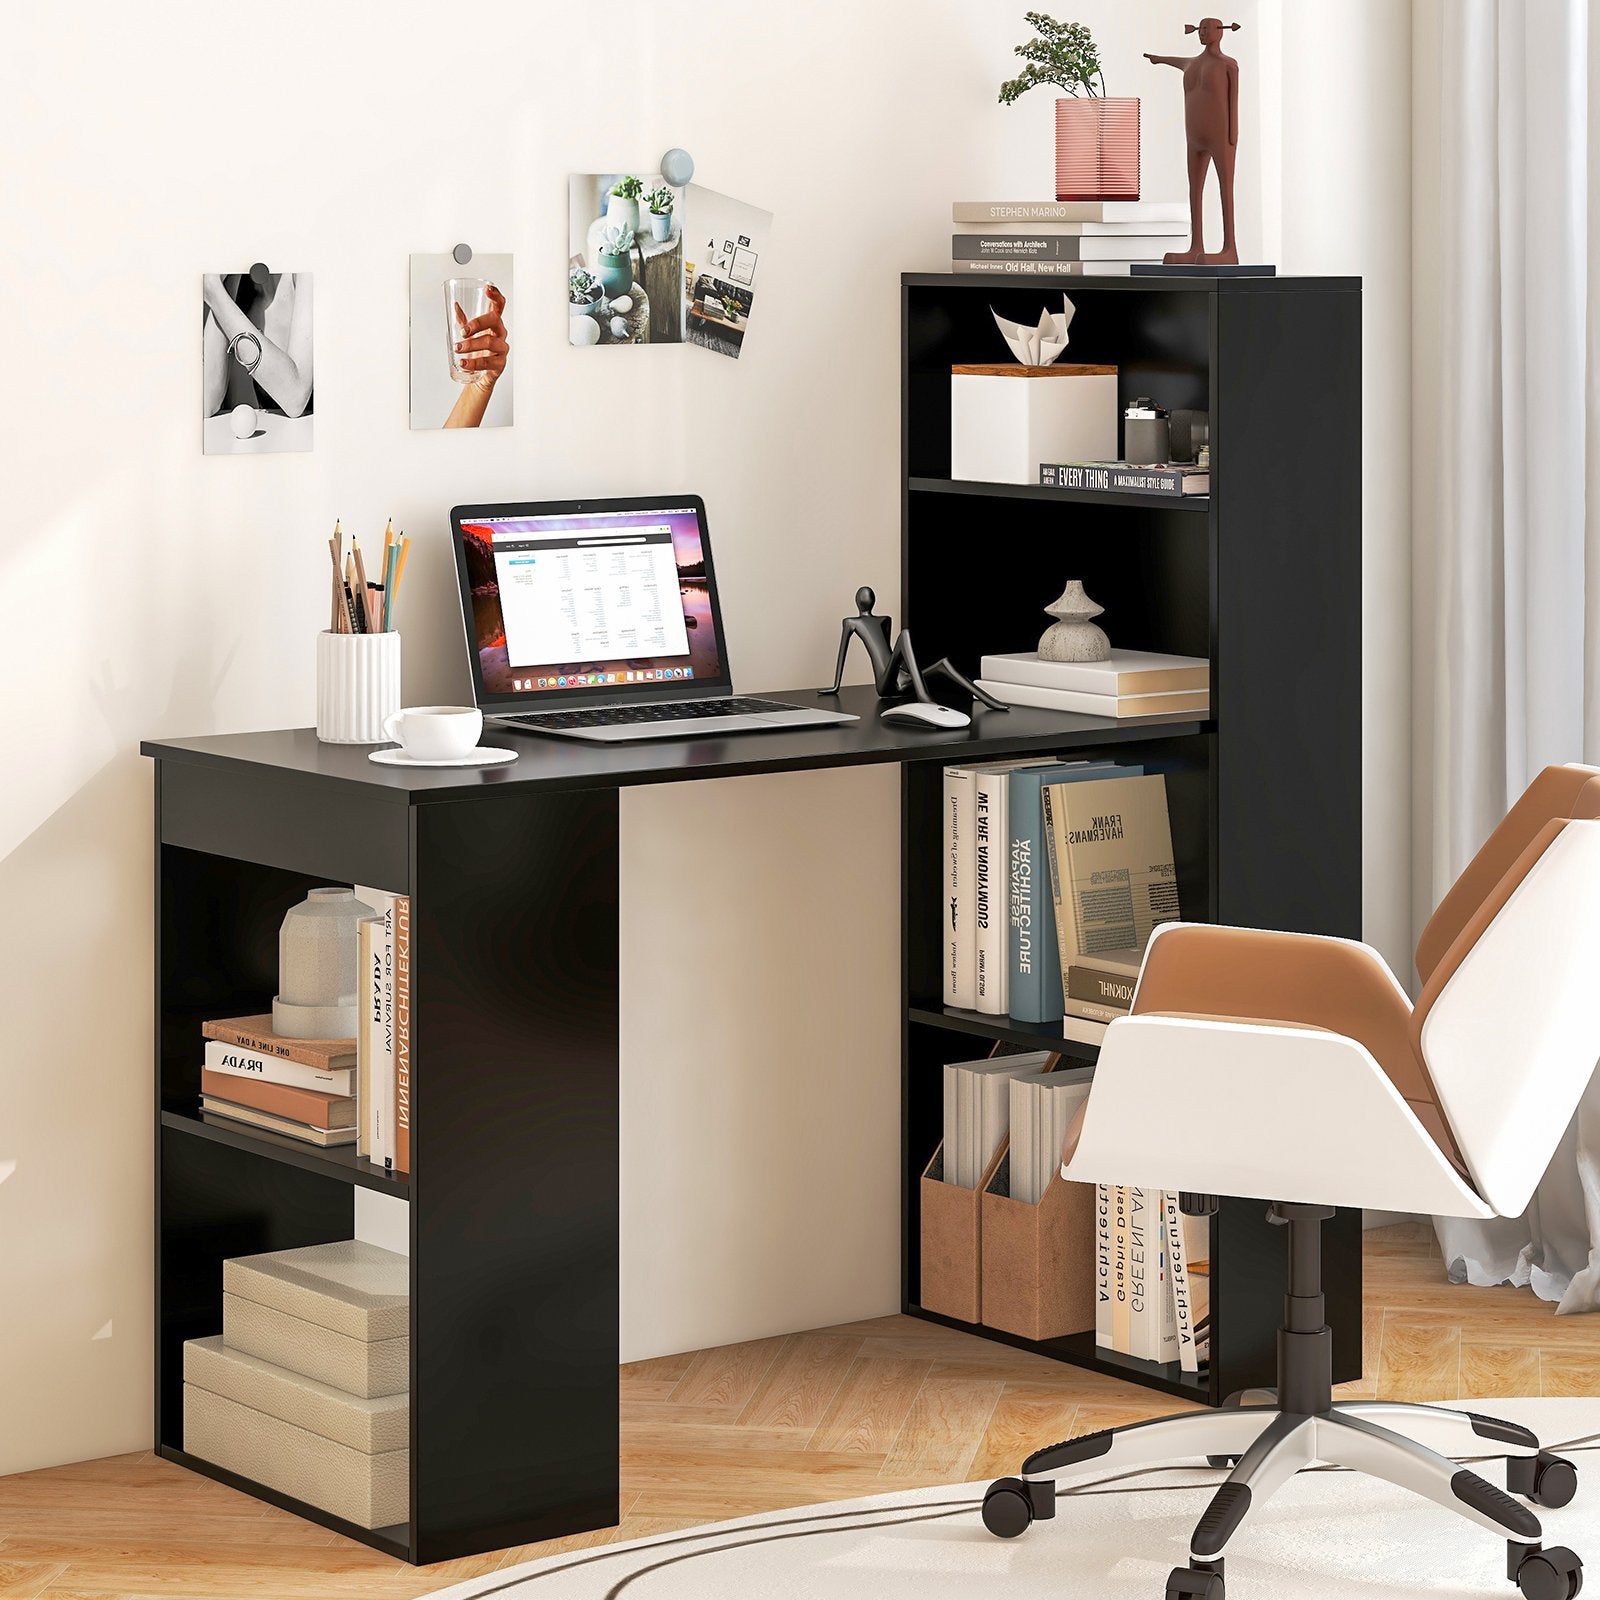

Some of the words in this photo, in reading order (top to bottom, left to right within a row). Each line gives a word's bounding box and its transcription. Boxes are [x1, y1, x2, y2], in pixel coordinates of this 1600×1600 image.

[990, 206, 1030, 217] STEPHEN
[1031, 206, 1066, 218] MARINO
[980, 240, 1013, 248] Conversations
[1013, 240, 1023, 248] with
[1023, 241, 1048, 249] Architects
[990, 263, 1004, 271] Innes
[1005, 262, 1019, 272] Old
[1020, 262, 1037, 274] Hall,
[1037, 262, 1055, 273] New
[1055, 262, 1071, 274] Hall
[1058, 467, 1083, 488] EVERY
[1085, 469, 1109, 489] THING
[1113, 474, 1117, 486] A
[1147, 477, 1160, 490] STYLE
